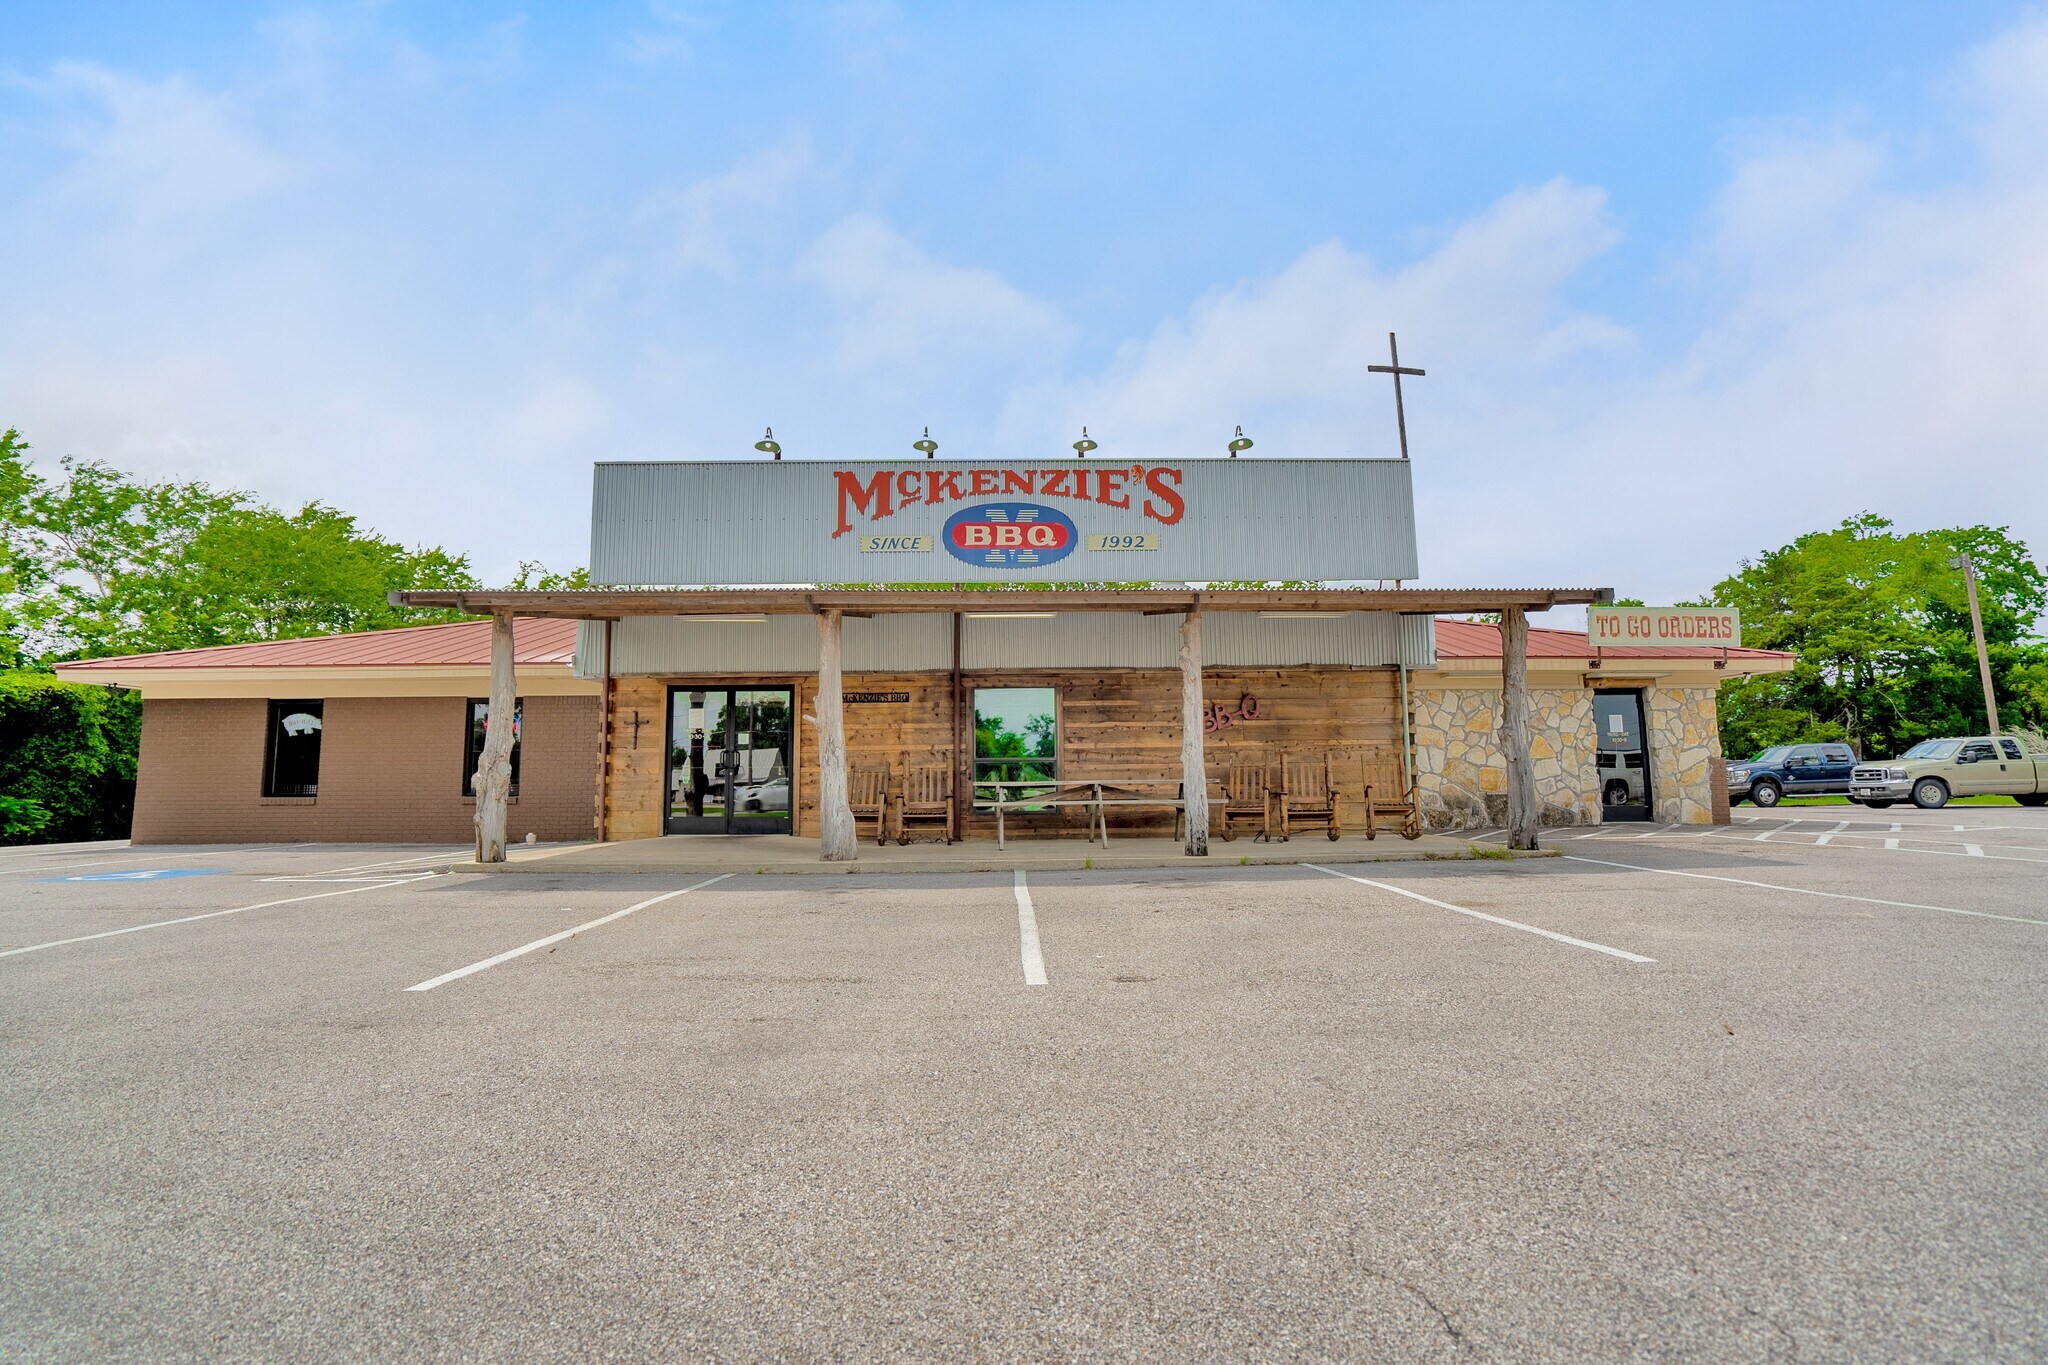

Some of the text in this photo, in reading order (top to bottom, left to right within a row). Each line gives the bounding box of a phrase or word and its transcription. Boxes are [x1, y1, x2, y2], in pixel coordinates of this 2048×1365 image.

[868, 537, 922, 550] SINCE
[964, 525, 1058, 547] BBQ
[1100, 535, 1145, 549] 1992
[1596, 615, 1732, 639] TO GO ORDERS
